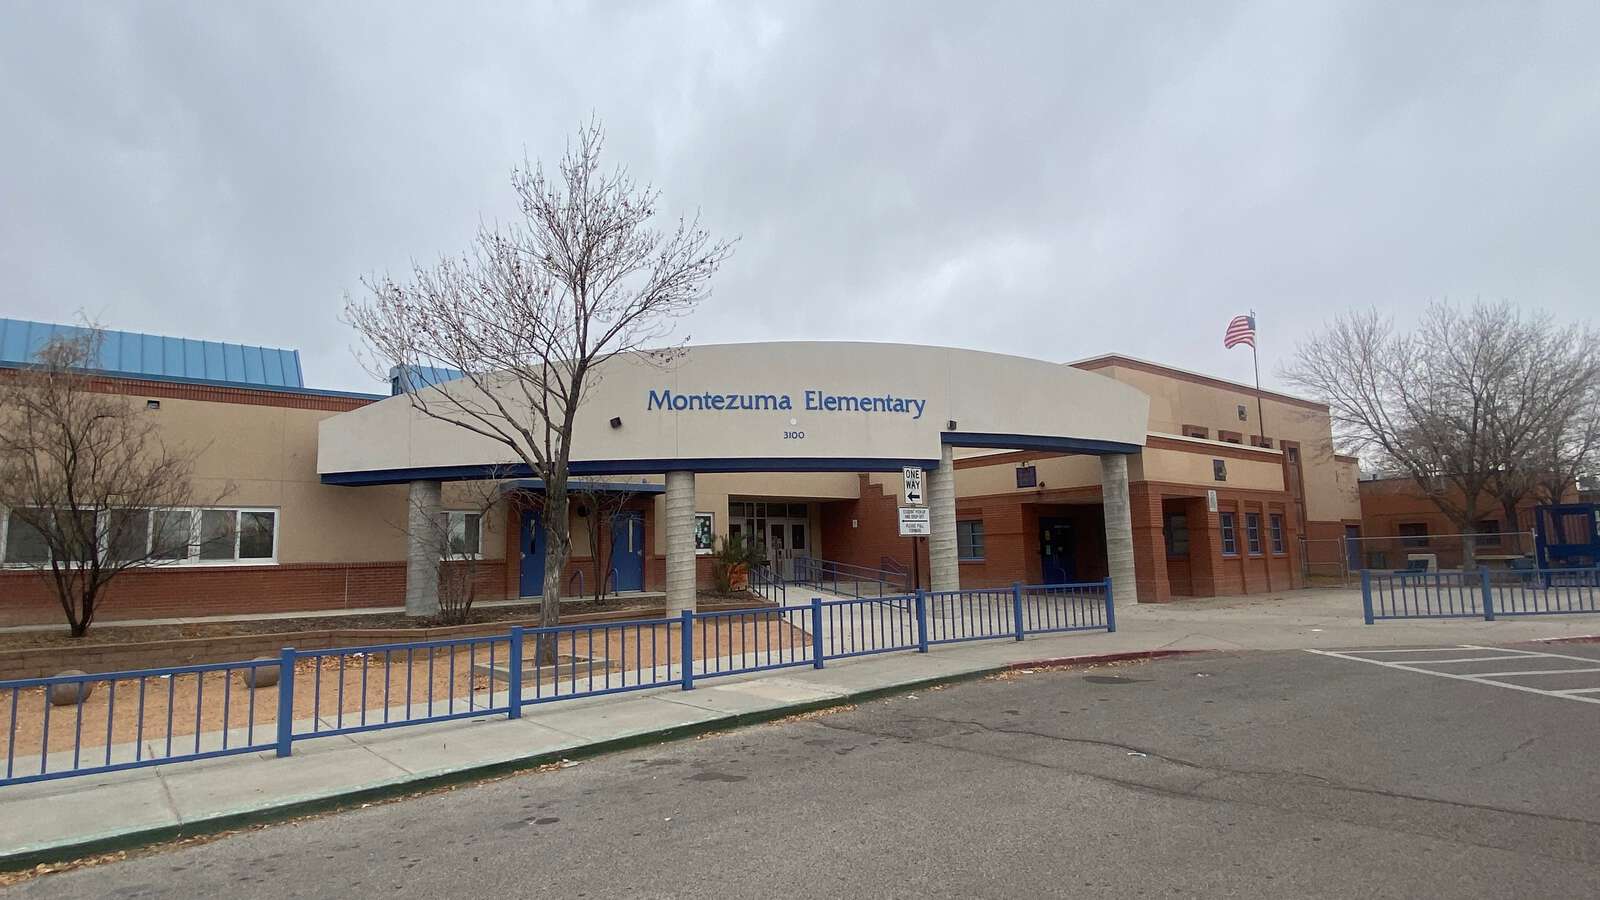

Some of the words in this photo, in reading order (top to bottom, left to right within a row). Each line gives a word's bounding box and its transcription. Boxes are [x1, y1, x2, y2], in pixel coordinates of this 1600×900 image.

[647, 390, 792, 411] Montezuma
[804, 390, 926, 419] Elementary
[783, 431, 805, 440] 3100
[905, 469, 920, 479] ONE
[906, 480, 920, 489] WAY
